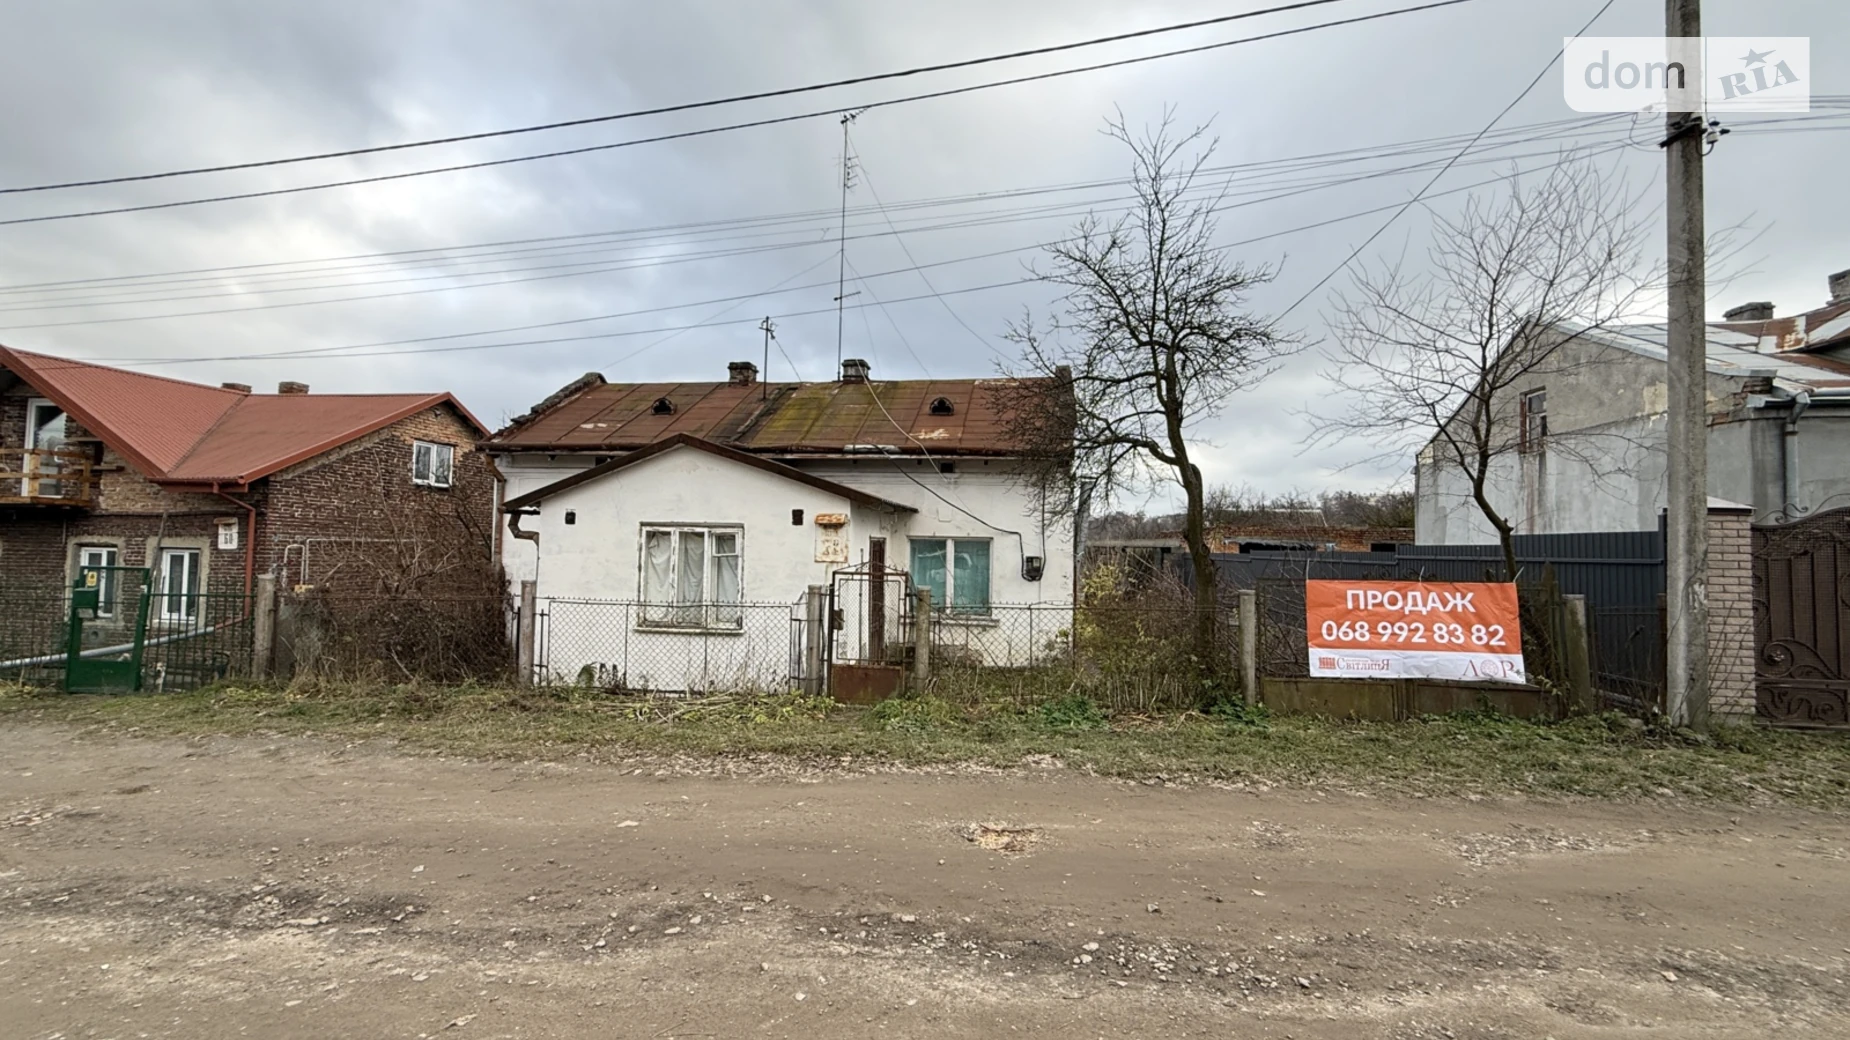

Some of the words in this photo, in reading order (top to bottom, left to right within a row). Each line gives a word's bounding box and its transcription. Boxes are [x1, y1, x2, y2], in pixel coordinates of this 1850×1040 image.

[1346, 590, 1476, 615] ПРОДАЖ
[1321, 620, 1370, 642] 068
[1377, 621, 1427, 643] 992
[1433, 622, 1465, 644] 83
[1471, 624, 1506, 646] 82
